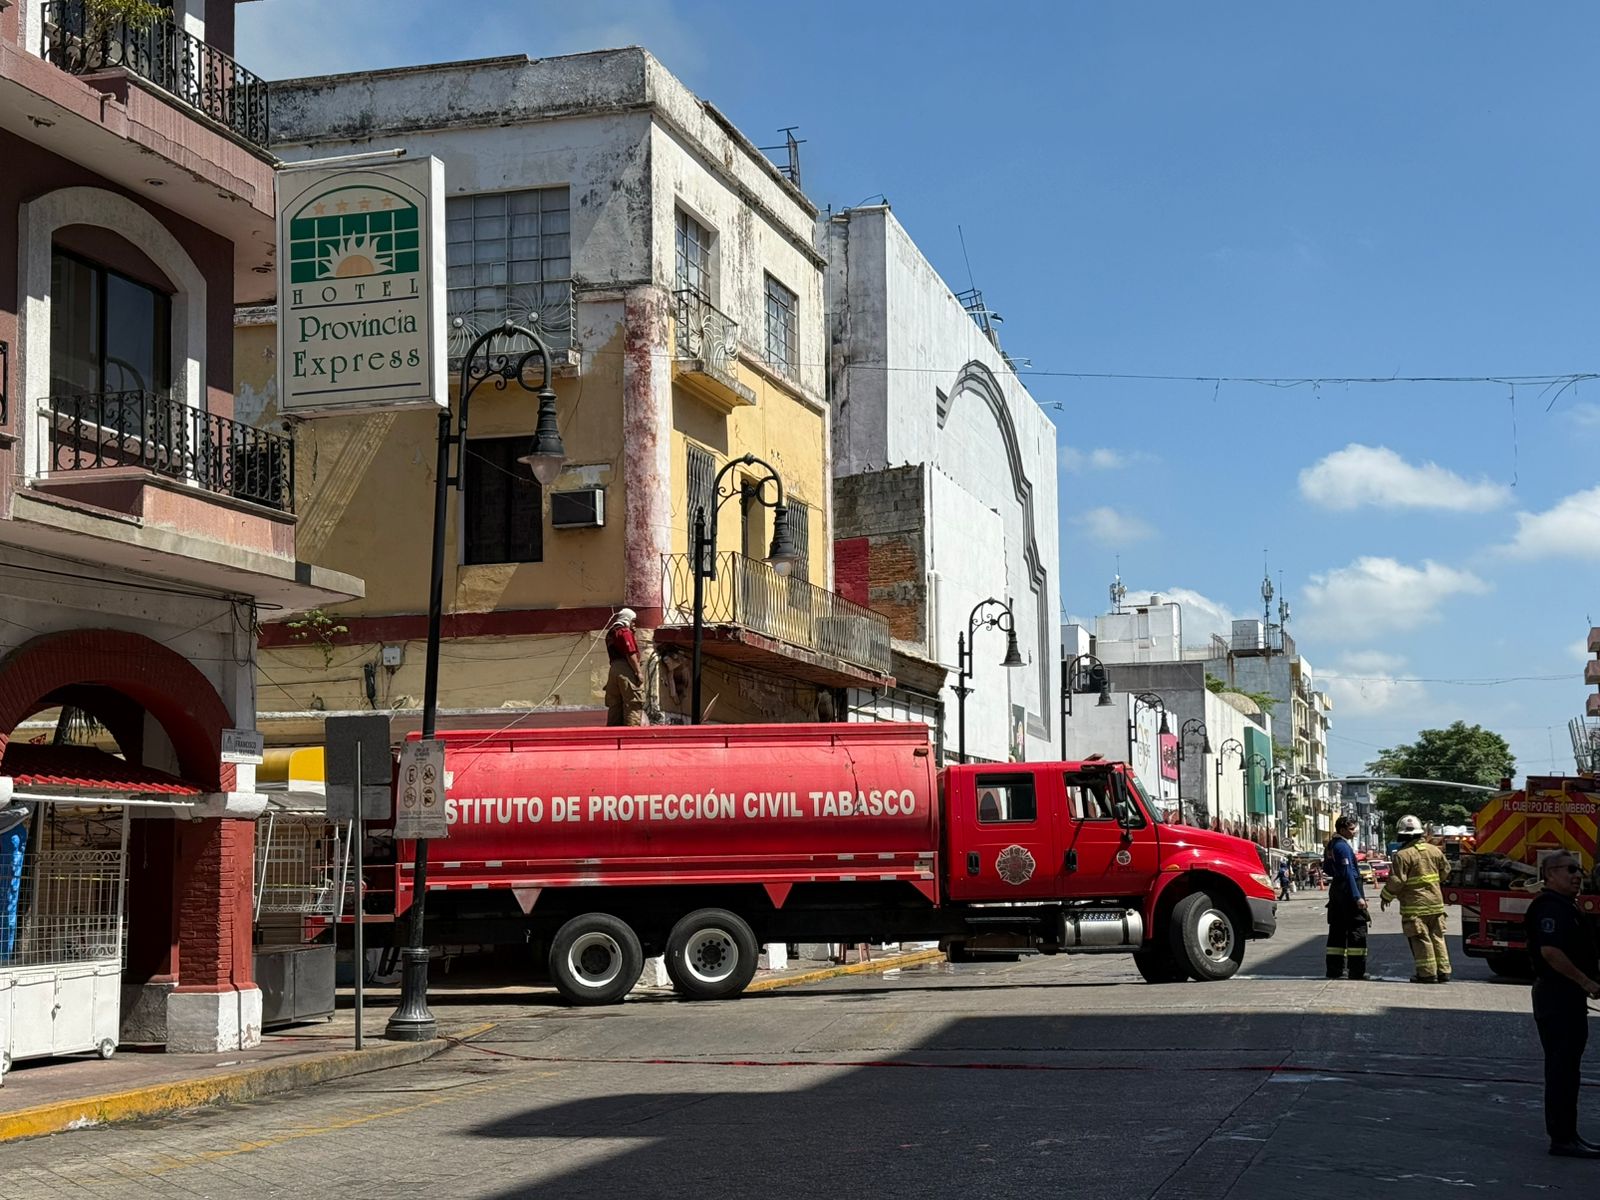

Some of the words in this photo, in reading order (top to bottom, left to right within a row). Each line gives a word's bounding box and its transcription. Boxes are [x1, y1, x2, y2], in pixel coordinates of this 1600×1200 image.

[292, 278, 419, 305] HOTEL
[299, 309, 417, 342] Provincia
[293, 348, 420, 383] Express
[444, 797, 544, 824] STITUTO
[551, 796, 581, 822] DE
[588, 788, 735, 821] PROTECCIÓN
[743, 791, 803, 819] CIVIL
[809, 789, 915, 817] TABASCO
[1512, 801, 1541, 812] CUERPO
[1543, 802, 1554, 812] DE
[1554, 802, 1596, 814] BOMBEROS
